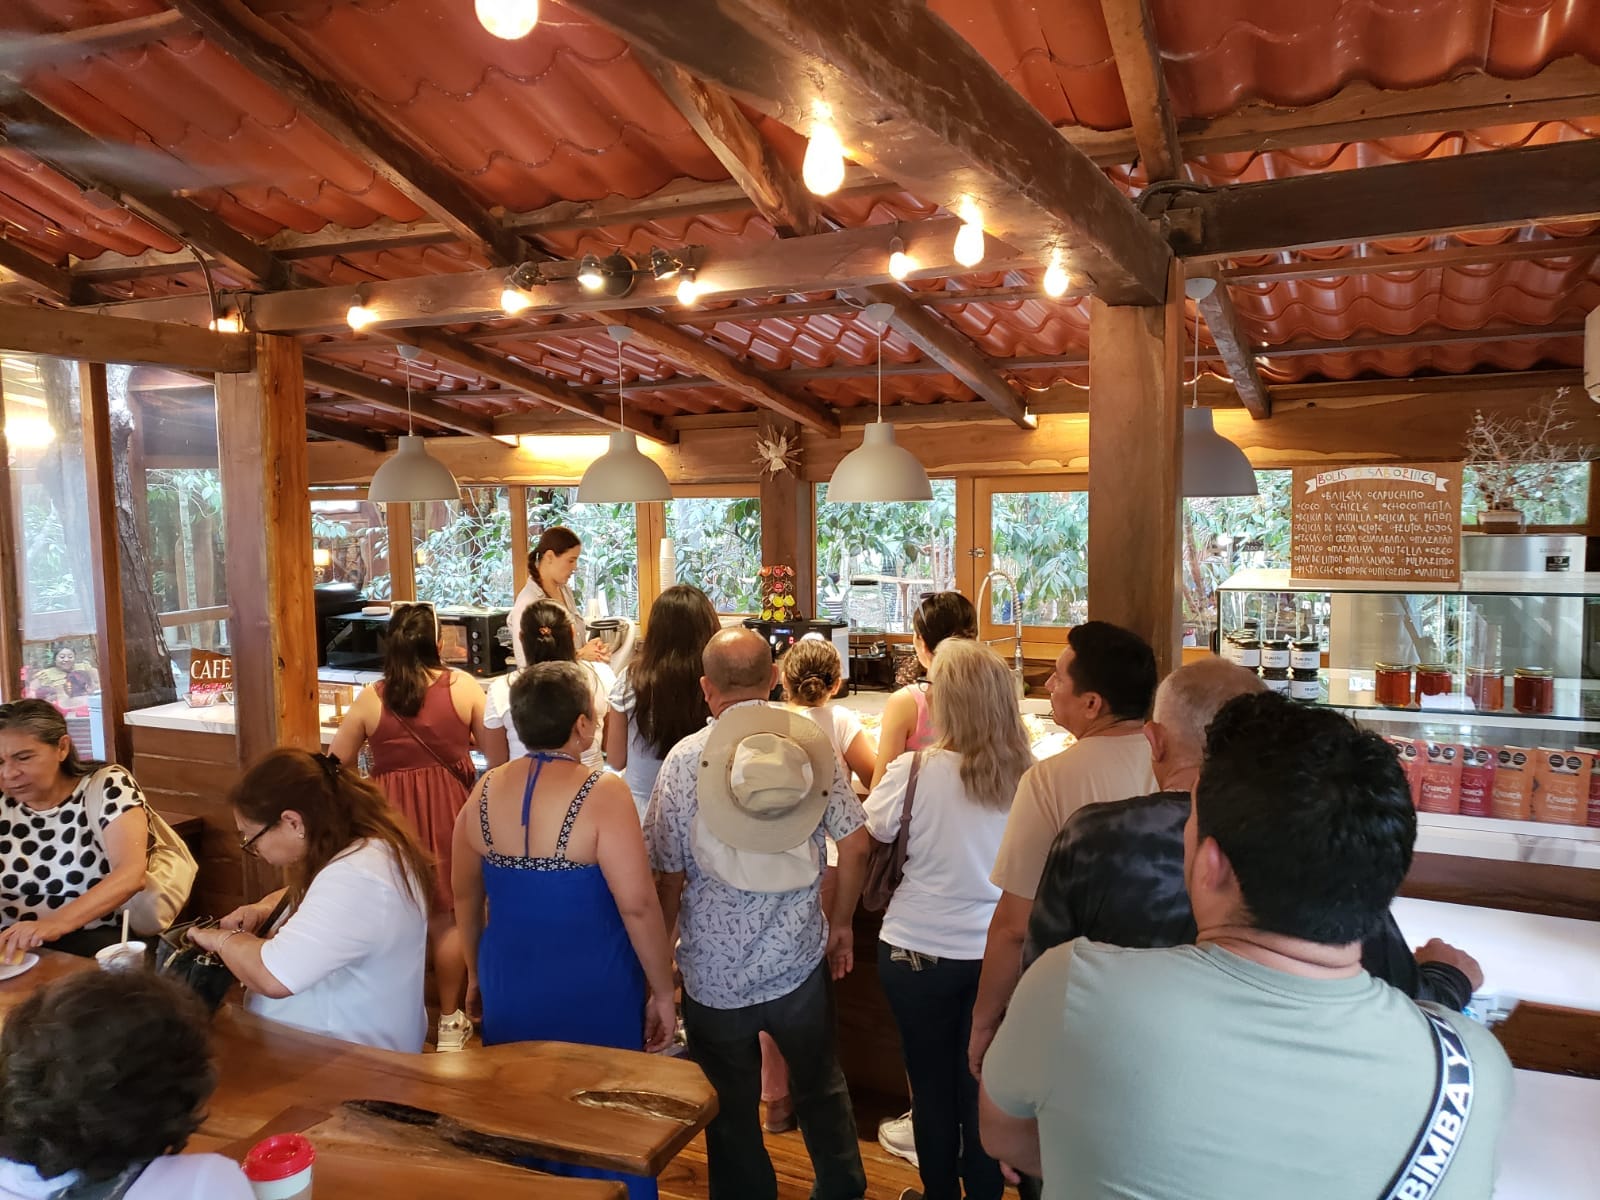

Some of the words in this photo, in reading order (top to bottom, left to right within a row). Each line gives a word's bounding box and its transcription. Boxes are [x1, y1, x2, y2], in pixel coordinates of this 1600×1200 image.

[1318, 470, 1348, 485] BOLIS
[1372, 490, 1425, 500] CAPUCHINO
[1300, 502, 1320, 511] COCO
[1335, 502, 1369, 512] CHICLE
[1387, 500, 1452, 511] CHOCOMENTA
[1384, 545, 1422, 556] NUTELLA
